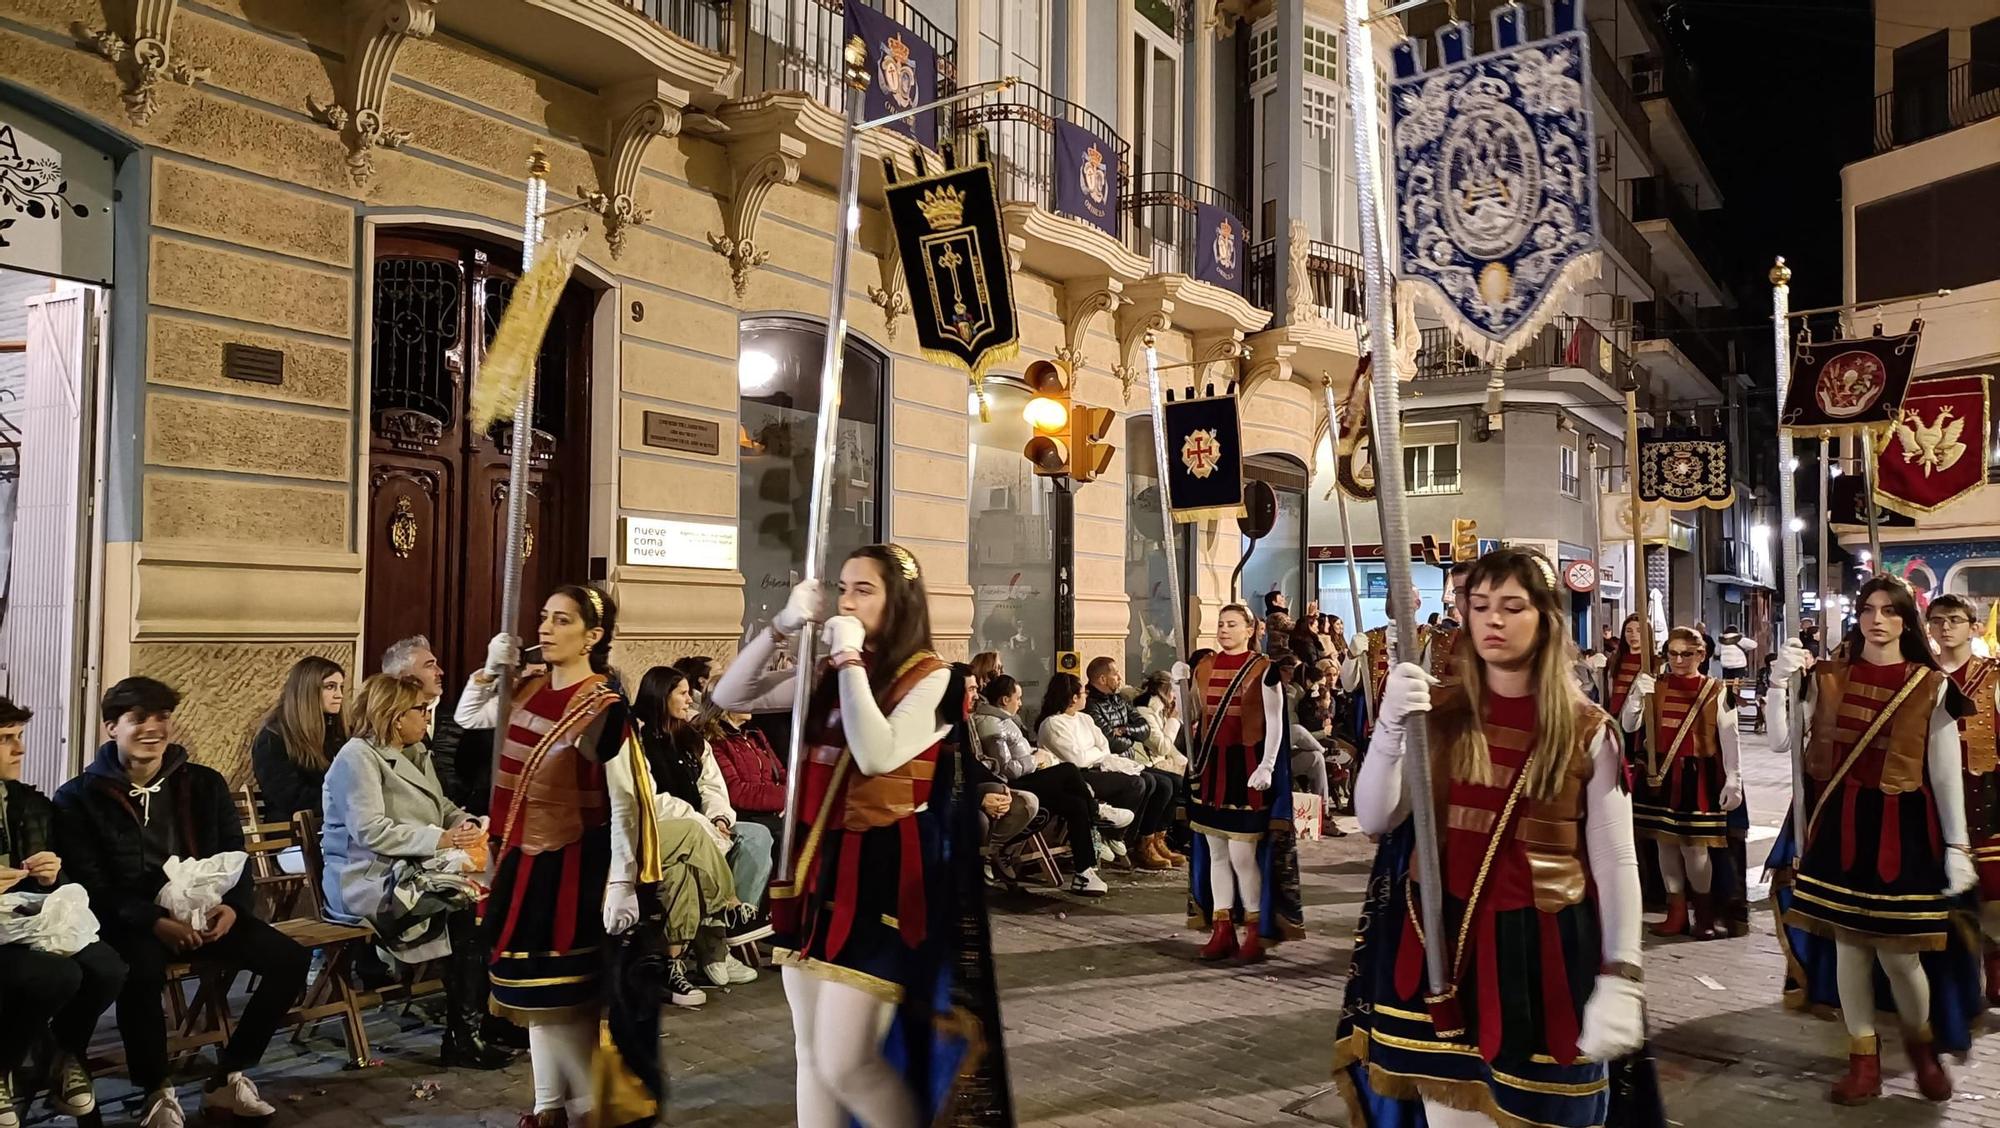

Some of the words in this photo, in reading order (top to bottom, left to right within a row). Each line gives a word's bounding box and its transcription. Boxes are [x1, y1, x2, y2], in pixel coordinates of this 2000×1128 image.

[631, 301, 644, 322] 9
[634, 527, 666, 536] nueve
[634, 537, 663, 547] coma
[634, 547, 666, 557] nueve
